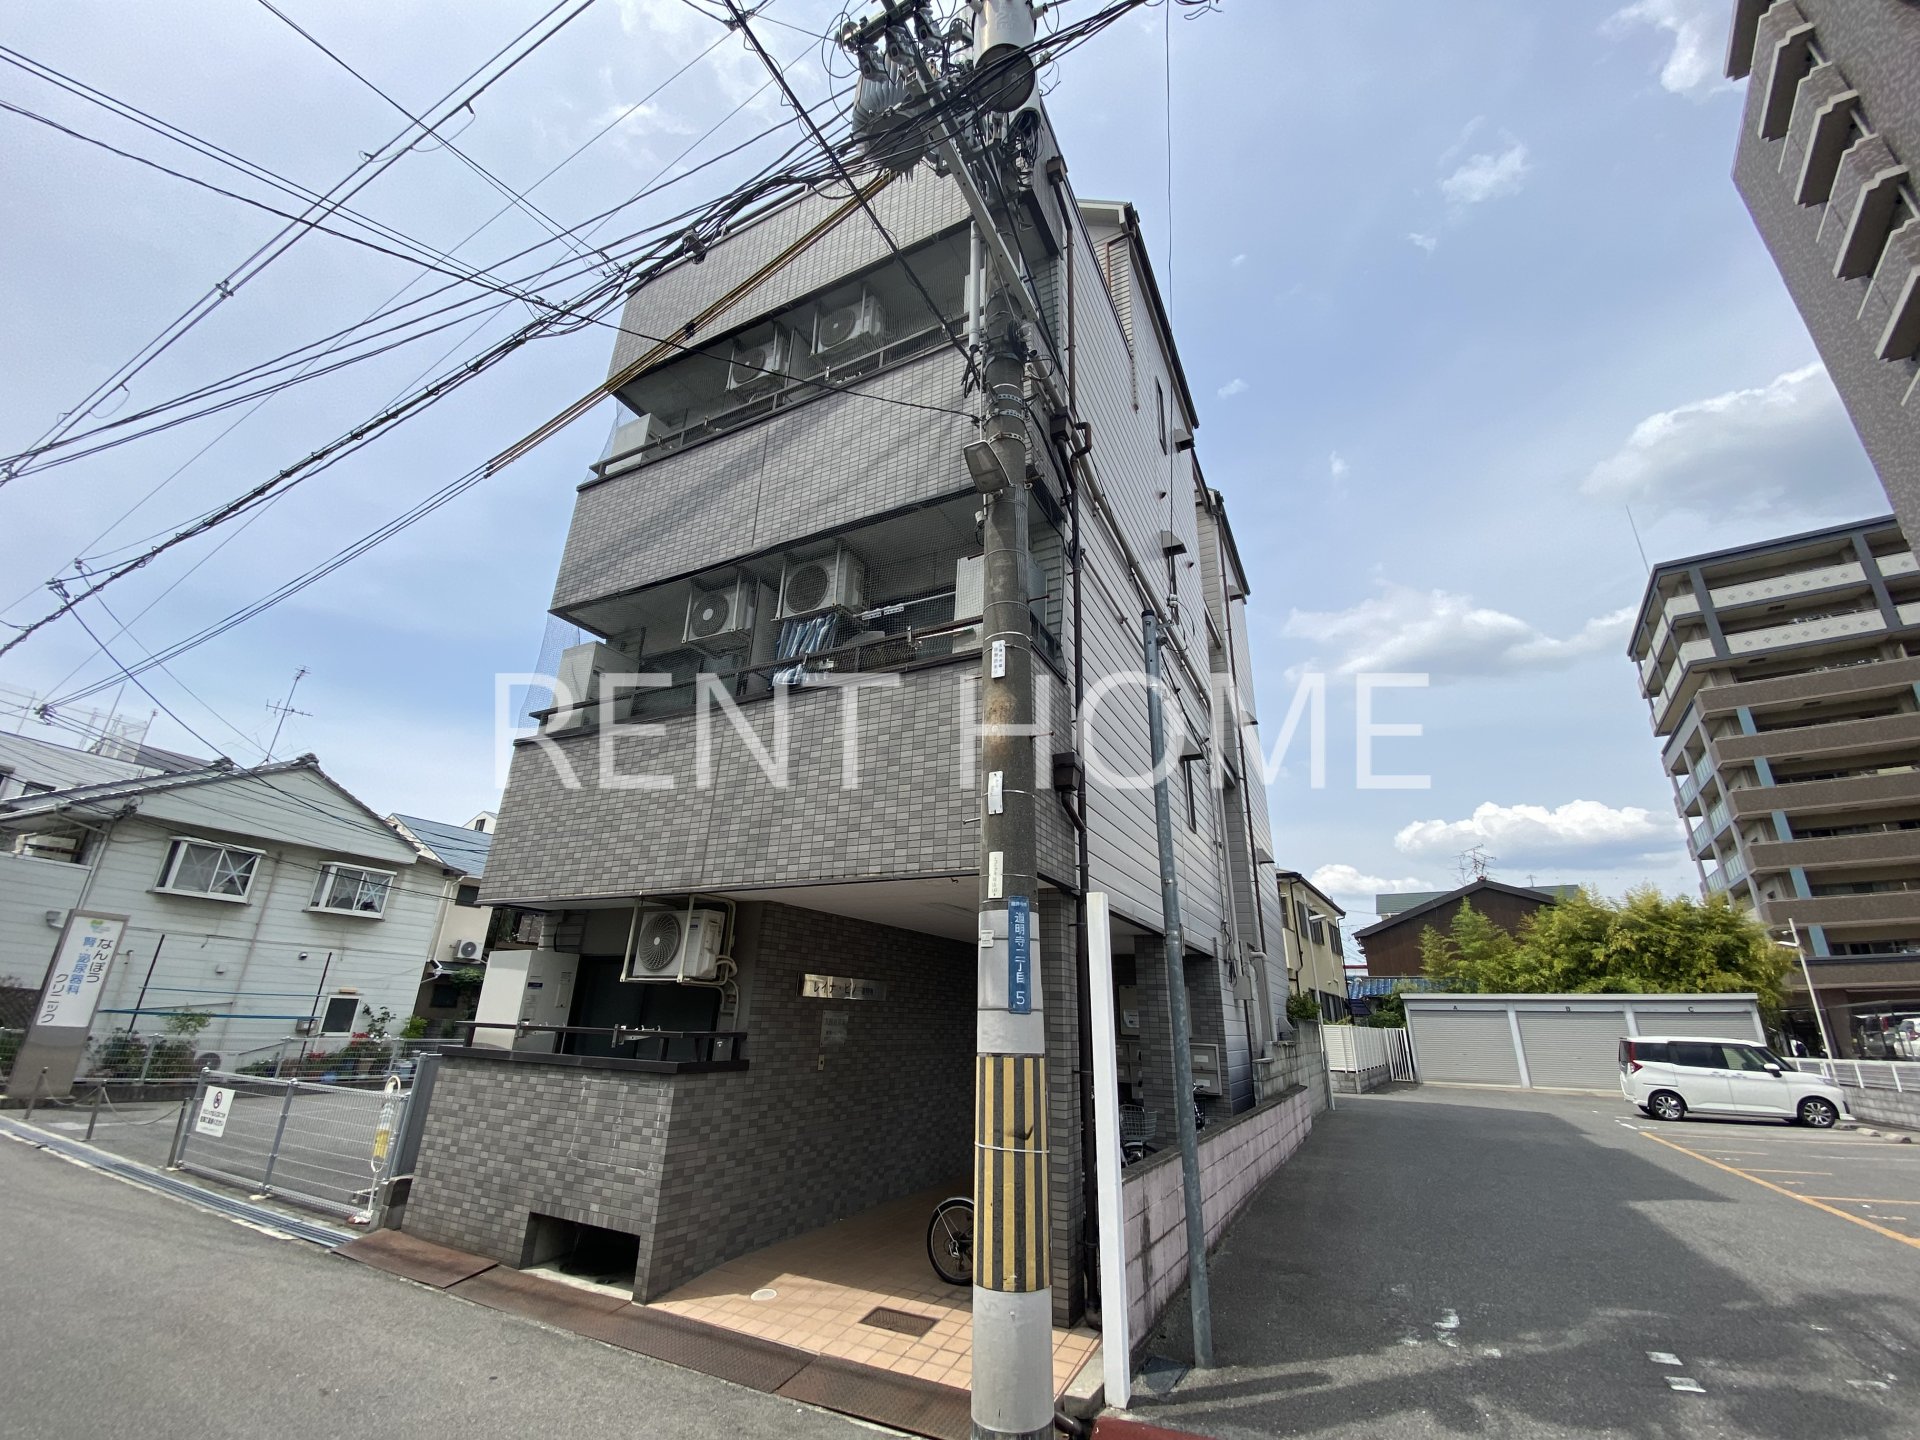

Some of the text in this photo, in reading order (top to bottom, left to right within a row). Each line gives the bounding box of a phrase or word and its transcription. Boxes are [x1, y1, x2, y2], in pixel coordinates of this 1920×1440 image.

[66, 936, 98, 995] 腎・泌尿器科
[86, 938, 114, 983] なんぼう
[1014, 912, 1026, 984] 道明寺二丁目
[40, 973, 69, 1024] クリニック
[1016, 991, 1025, 1005] 5
